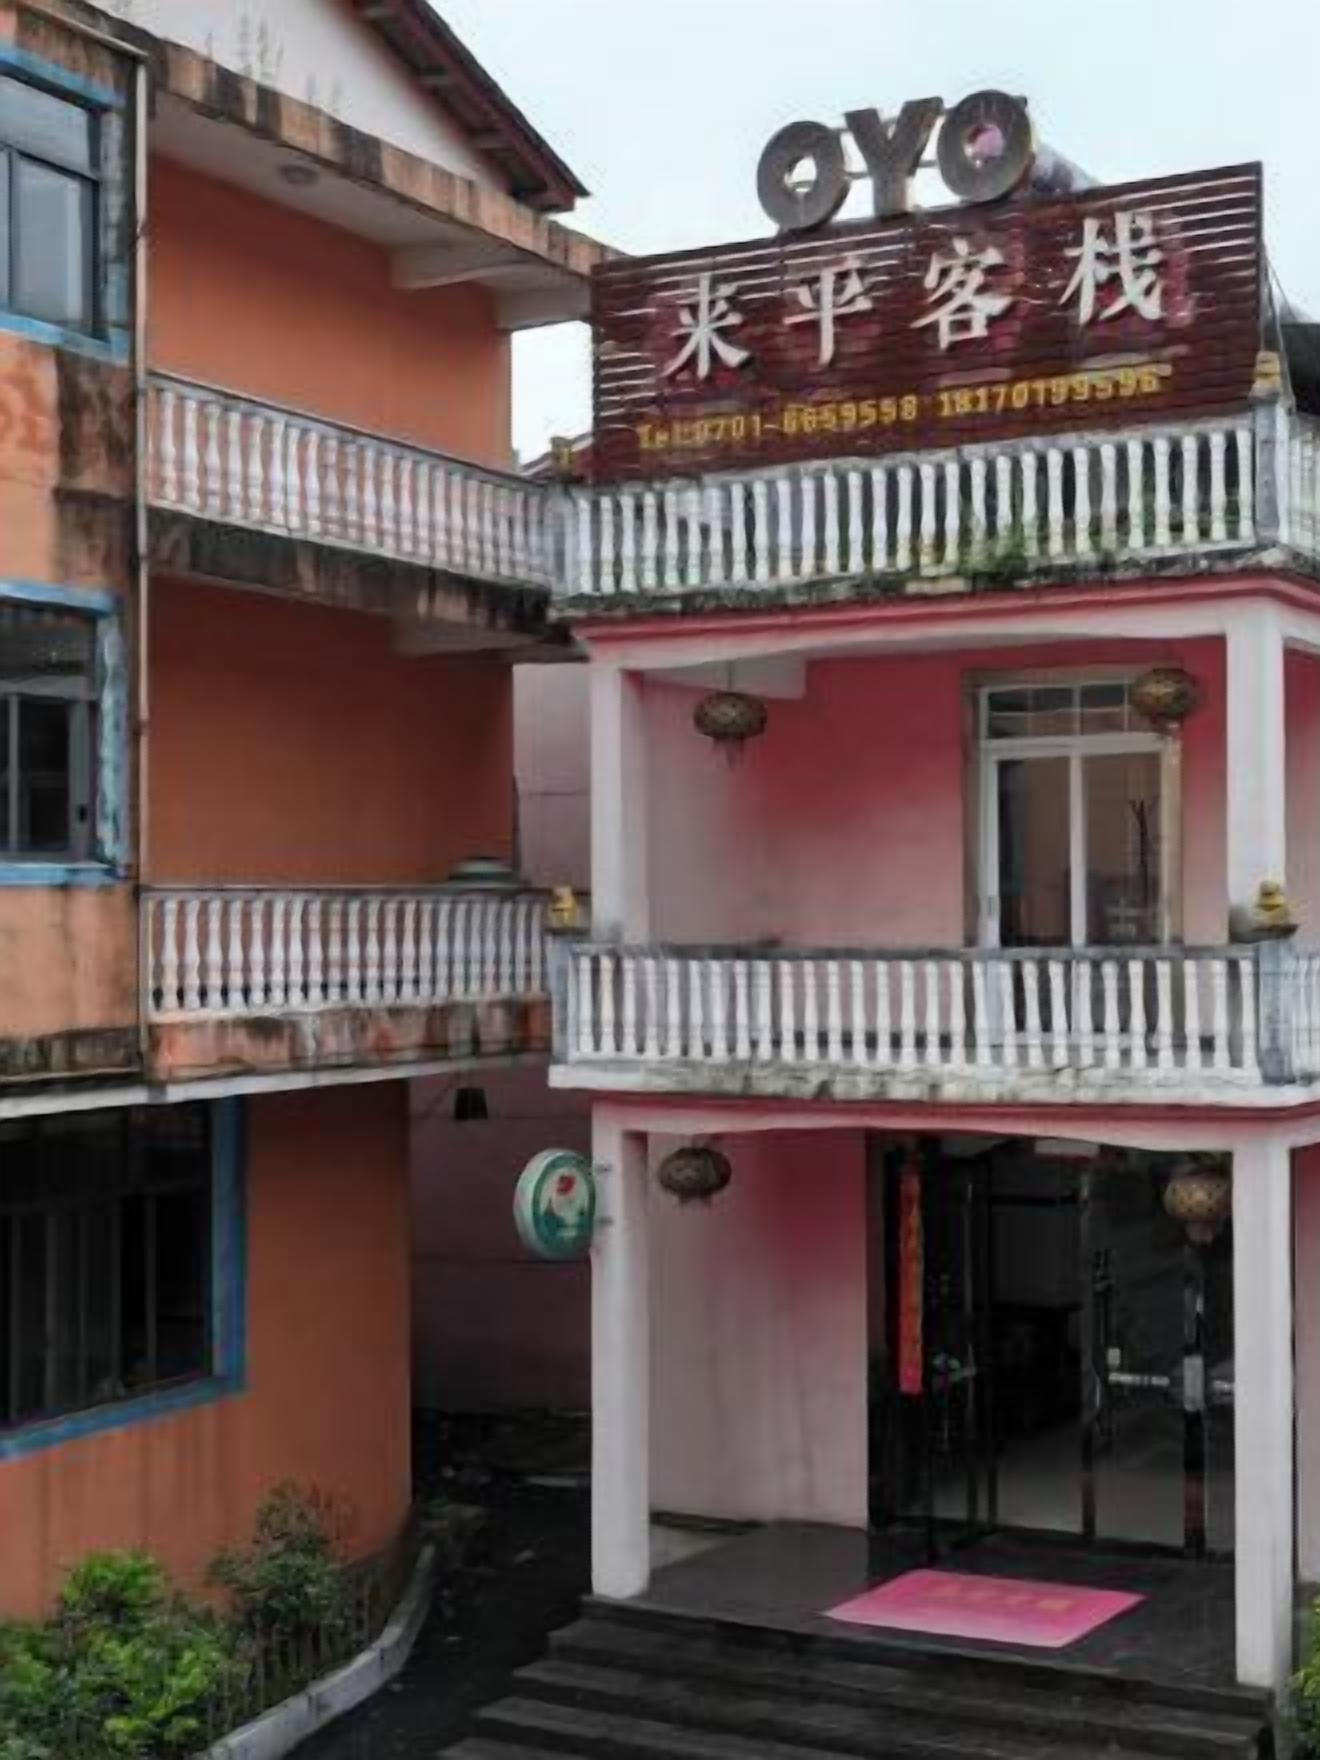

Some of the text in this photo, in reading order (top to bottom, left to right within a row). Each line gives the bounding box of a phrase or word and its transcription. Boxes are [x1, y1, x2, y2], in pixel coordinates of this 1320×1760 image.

[756, 89, 1034, 232] OYO
[663, 210, 1165, 379] 来平客栈
